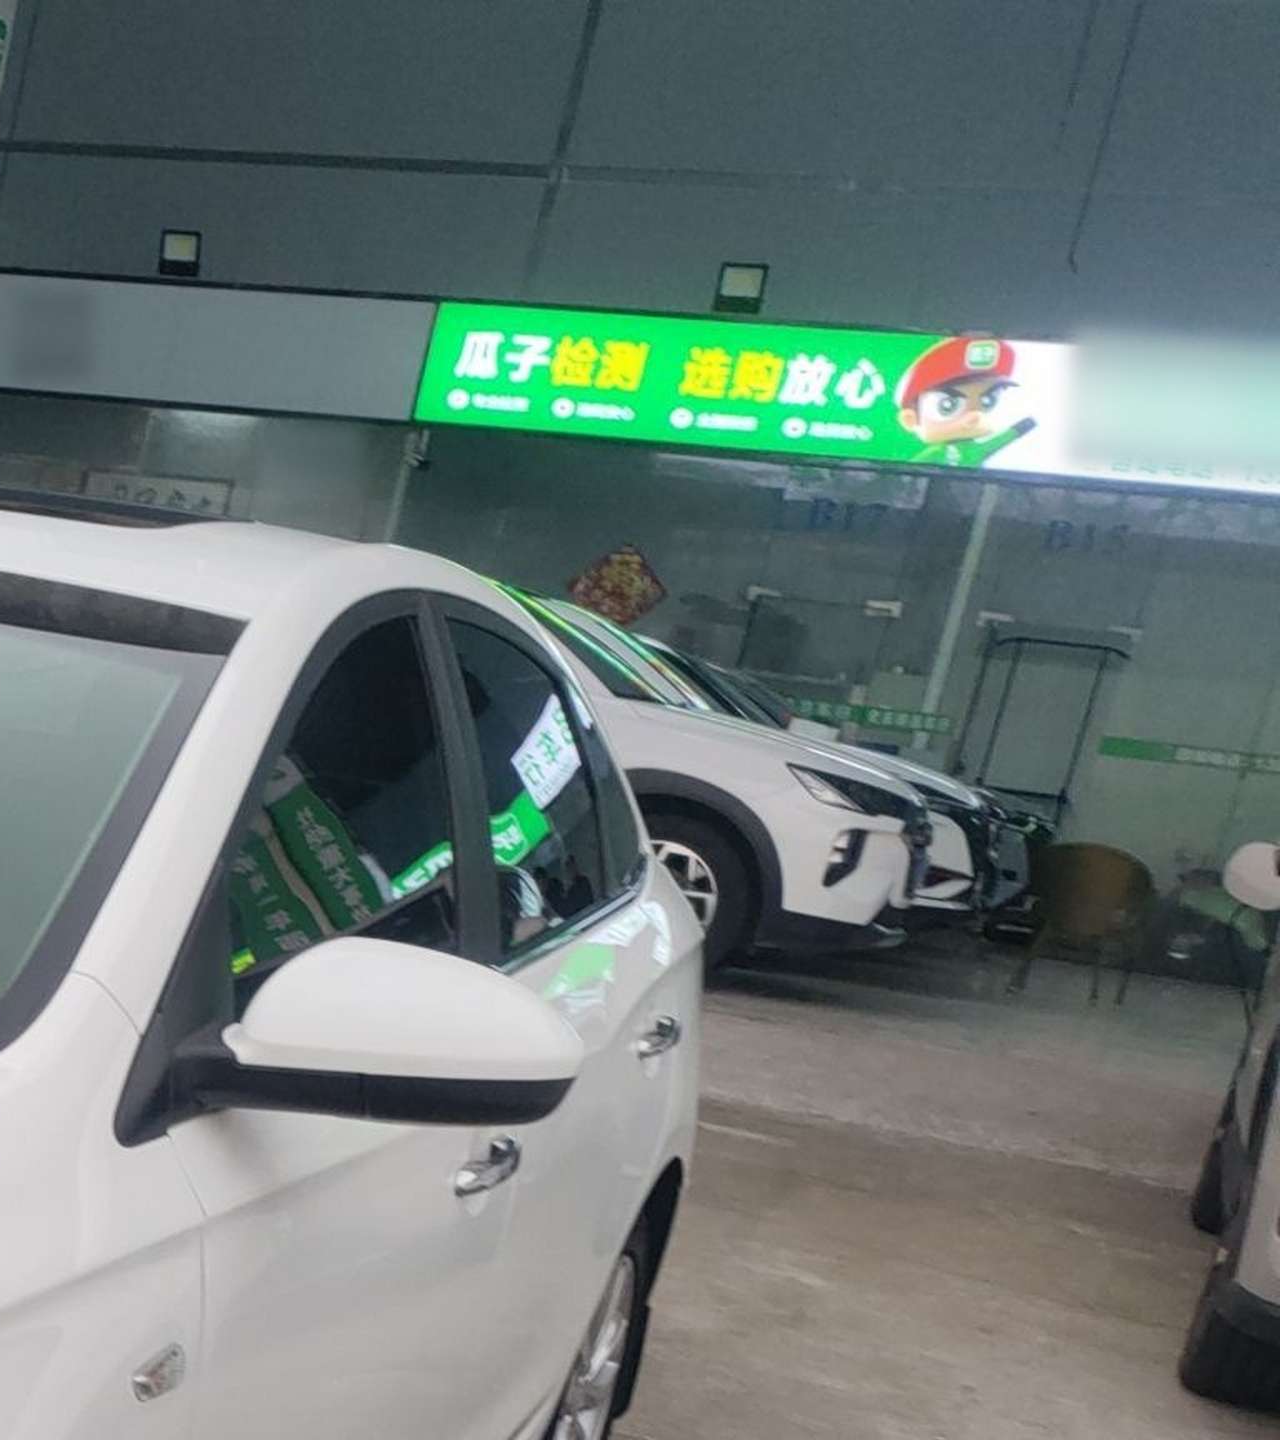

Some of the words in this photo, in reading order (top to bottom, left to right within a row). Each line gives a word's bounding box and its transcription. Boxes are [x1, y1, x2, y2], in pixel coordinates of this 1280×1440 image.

[453, 331, 650, 391] 瓜子检测
[678, 346, 886, 409] 选购放心
